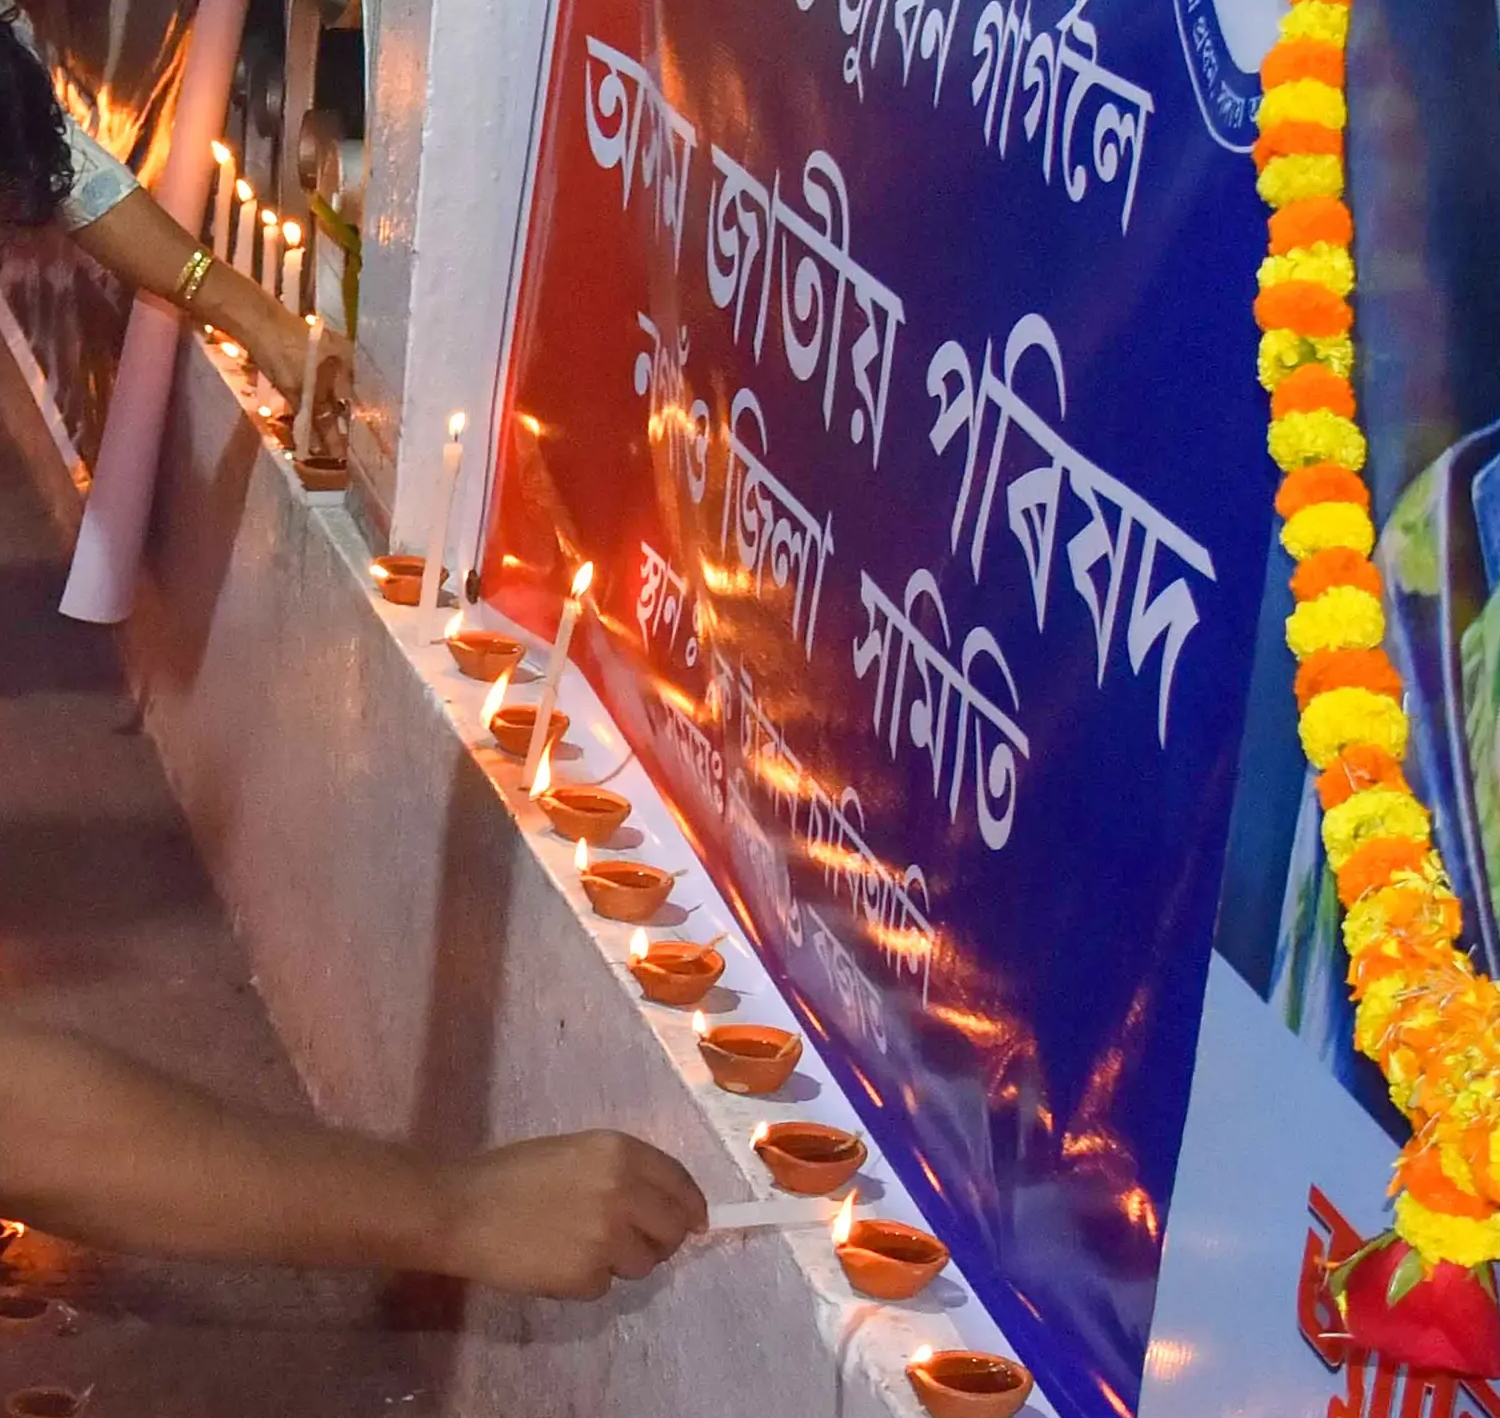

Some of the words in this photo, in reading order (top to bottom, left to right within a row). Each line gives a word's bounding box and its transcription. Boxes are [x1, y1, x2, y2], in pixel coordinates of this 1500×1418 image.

[585, 35, 697, 275] অসম
[706, 143, 906, 471] জাতীয়
[926, 312, 1217, 750] পৰিষদ
[720, 388, 834, 663] জিলা
[853, 568, 1030, 850] সমিতি
